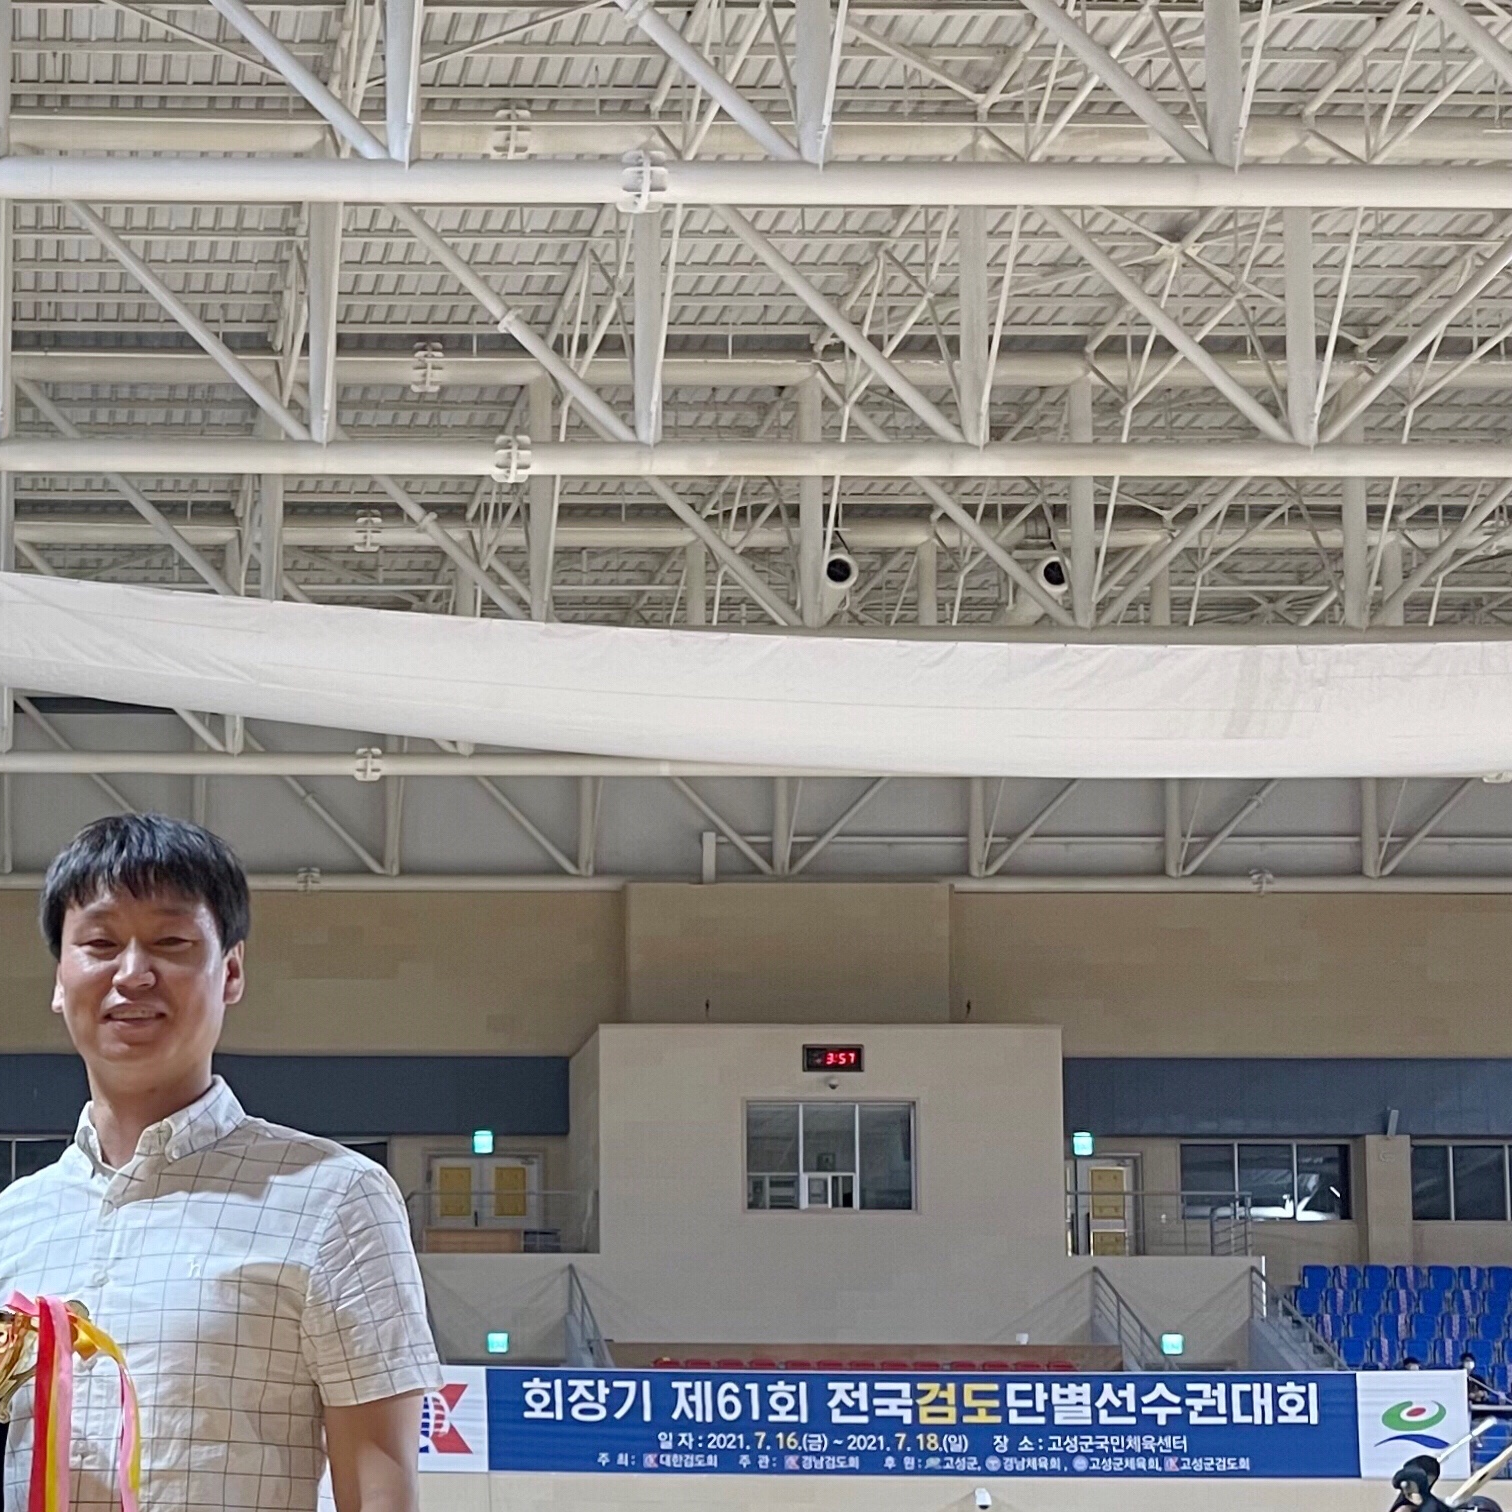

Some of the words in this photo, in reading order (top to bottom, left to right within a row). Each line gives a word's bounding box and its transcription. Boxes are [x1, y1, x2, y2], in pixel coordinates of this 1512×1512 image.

[522, 1377, 651, 1423] 회장기
[671, 1380, 808, 1424] 제61회
[826, 1381, 1319, 1426] 전국검도단별선수권대회
[707, 1433, 750, 1450] 2021.
[847, 1434, 890, 1452] 2021.
[1047, 1435, 1187, 1453] 고성군국민체육센터
[659, 1453, 718, 1468] 대한검도회
[1180, 1457, 1250, 1472] 고성군검도회
